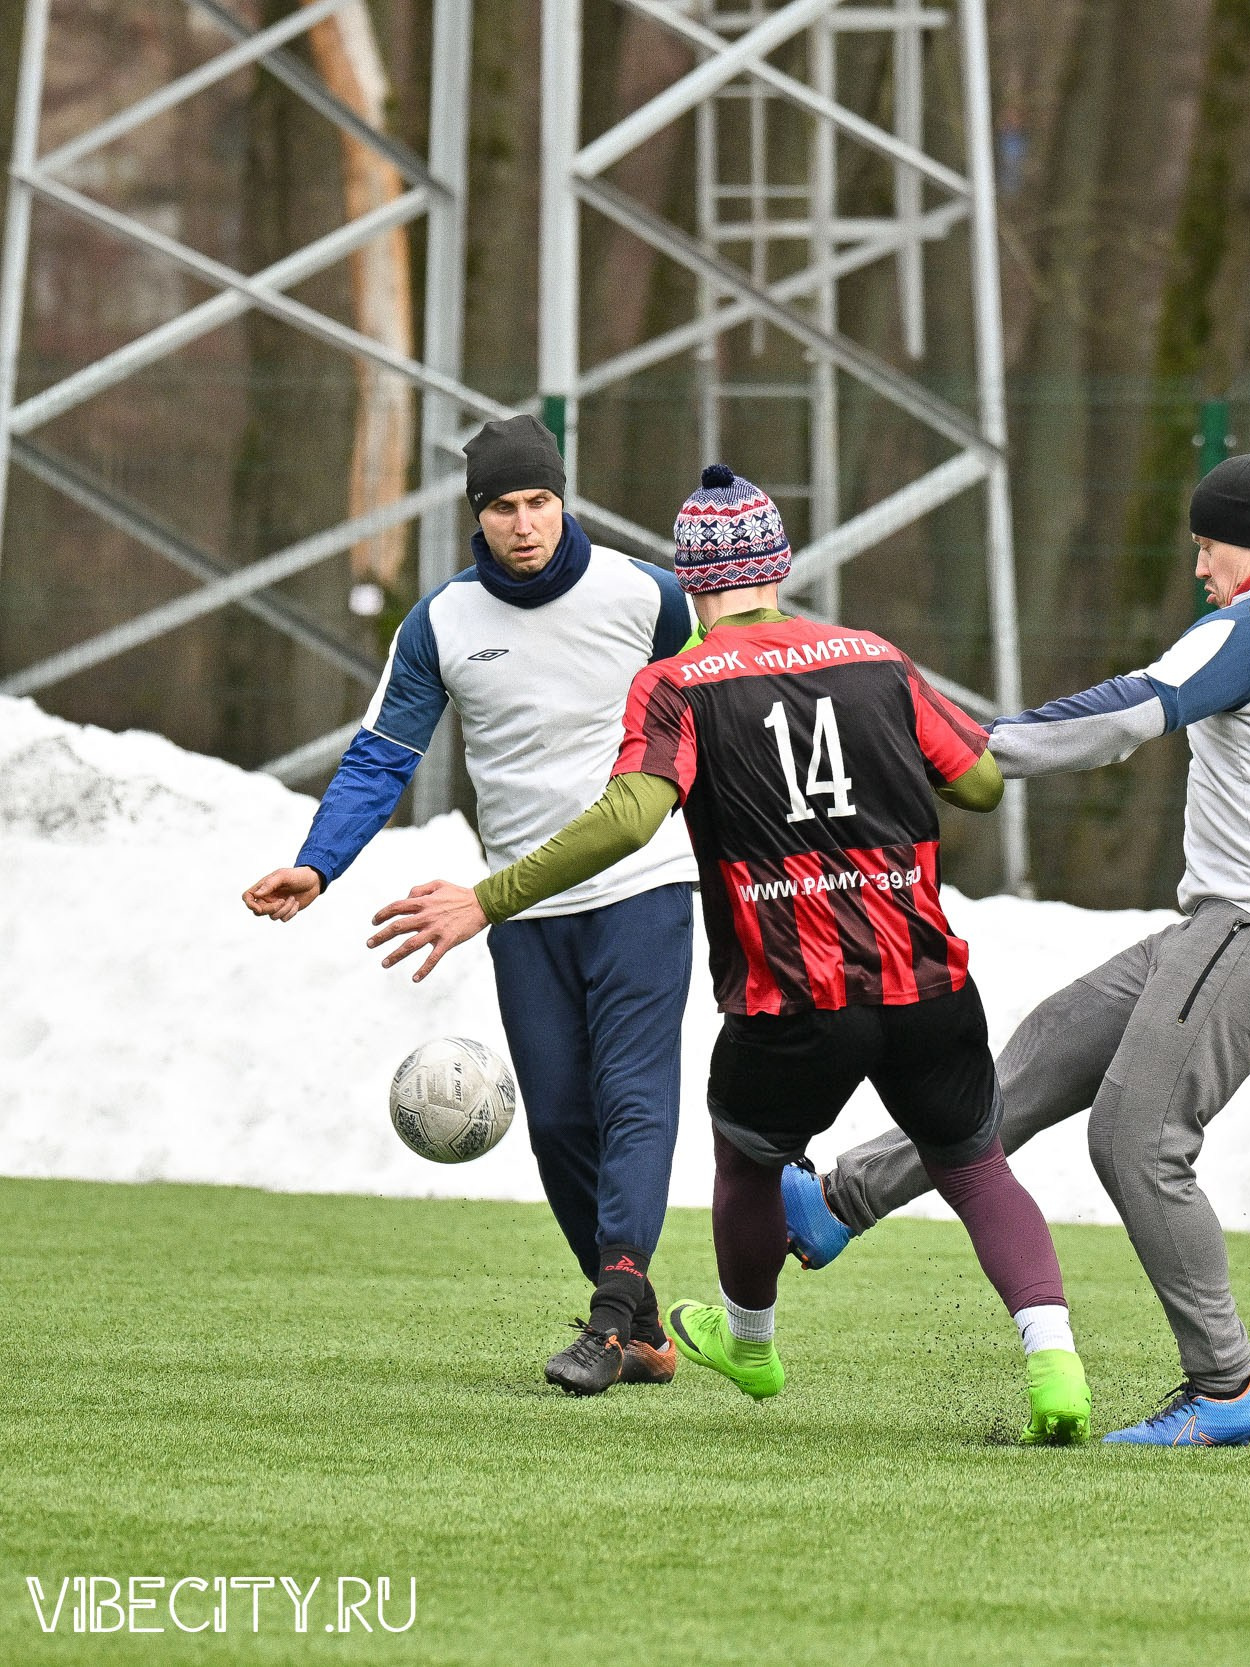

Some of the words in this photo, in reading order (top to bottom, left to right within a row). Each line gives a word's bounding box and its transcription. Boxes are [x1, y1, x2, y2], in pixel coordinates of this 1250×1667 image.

[680, 650, 746, 682] ЛФК
[753, 637, 889, 669] «ПАМЯТЬ»
[763, 695, 857, 824] 14
